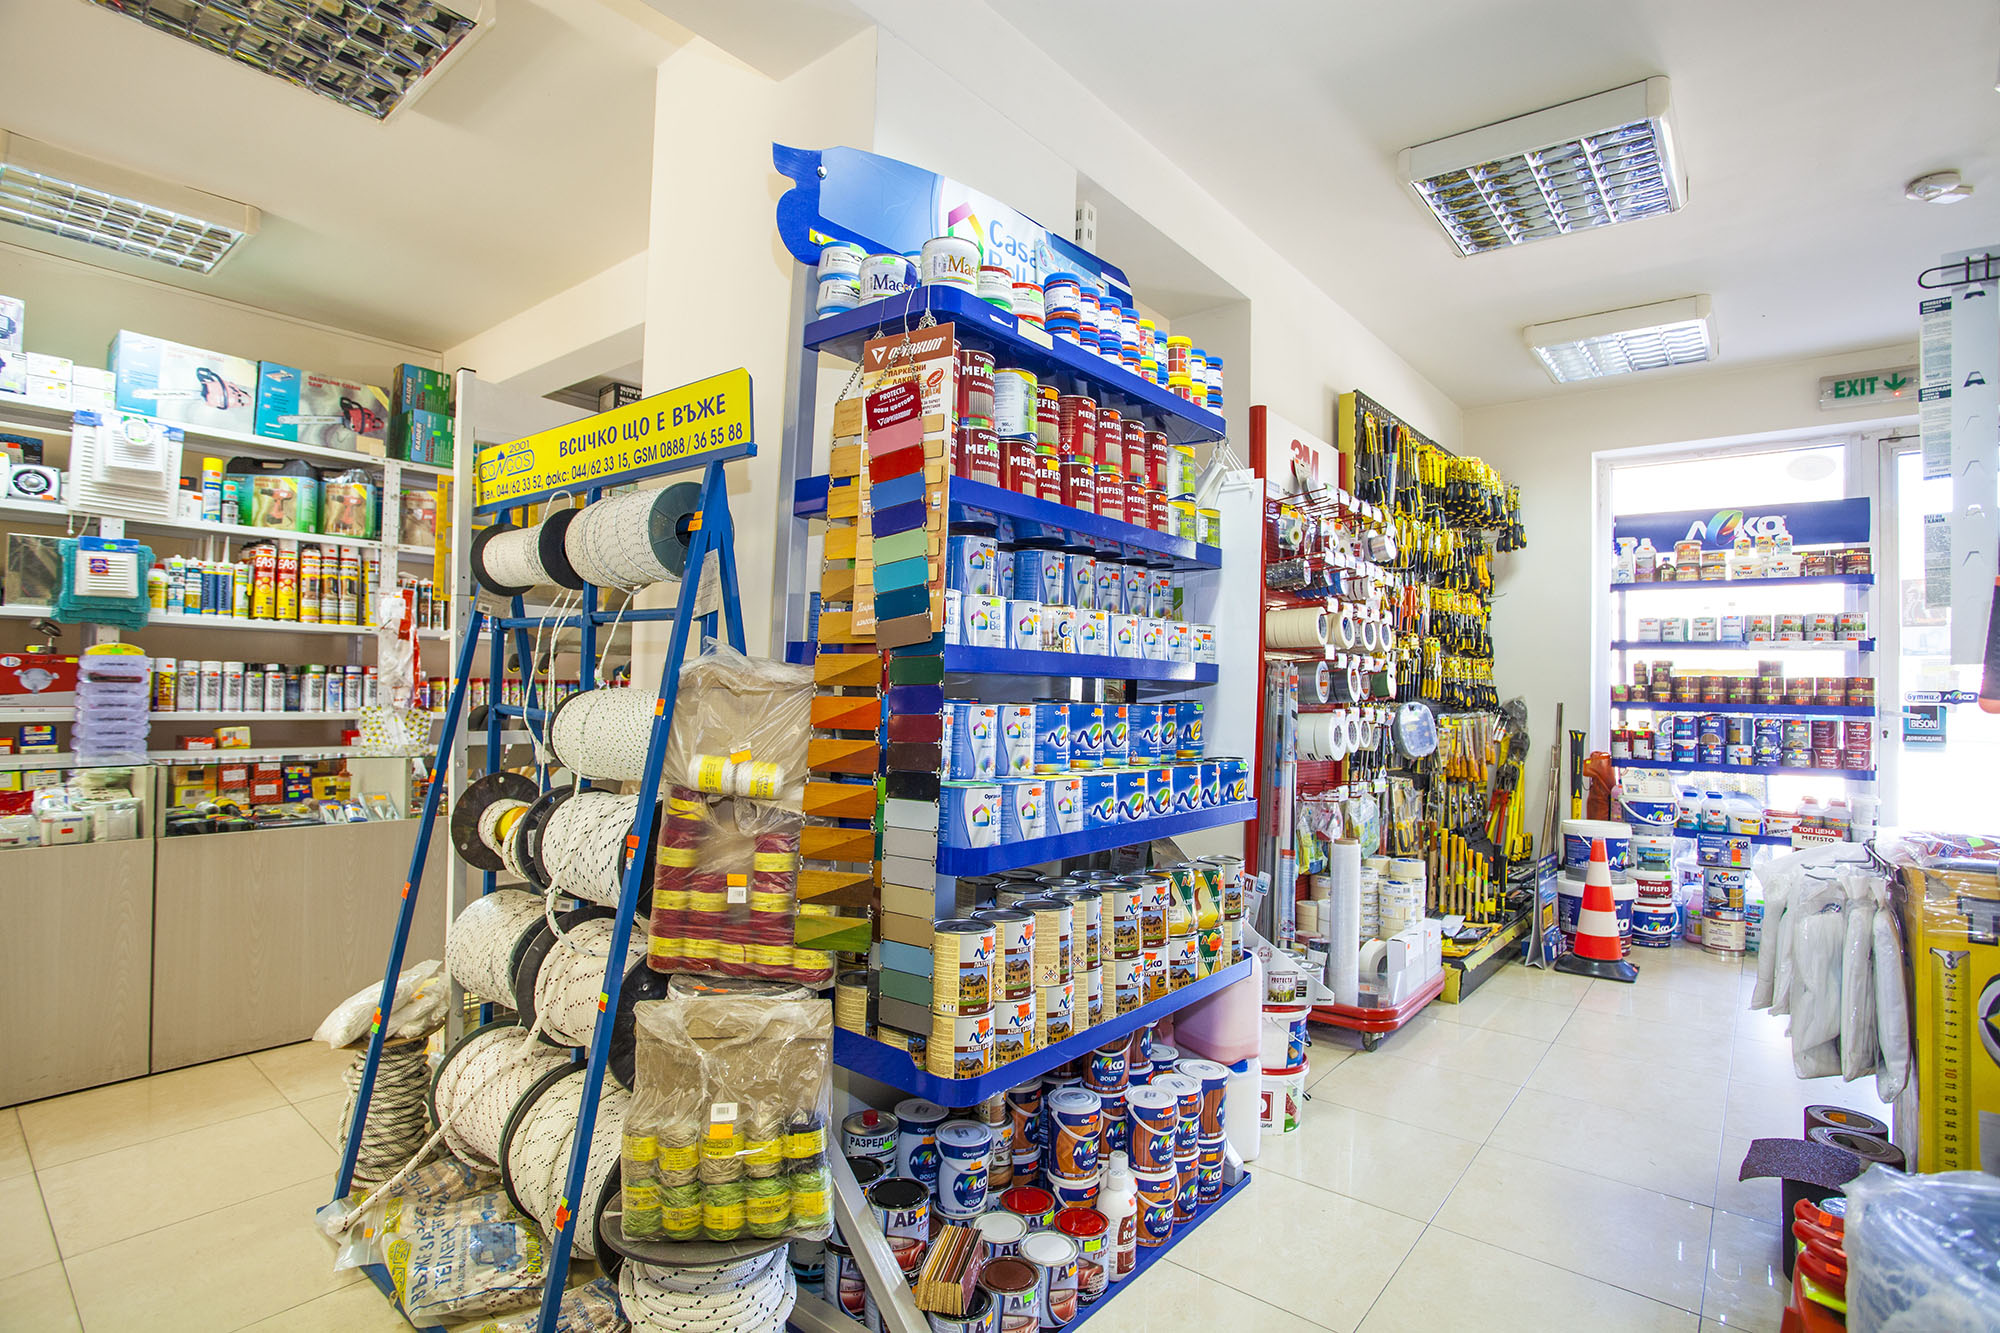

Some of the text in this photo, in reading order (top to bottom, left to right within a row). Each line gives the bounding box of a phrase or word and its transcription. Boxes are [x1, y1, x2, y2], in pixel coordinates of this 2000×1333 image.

[307, 375, 340, 387] GASOLINE
[879, 386, 906, 401] PROTECTA
[1834, 376, 1879, 399] EXIT
[559, 426, 617, 458] ВСИЧКО
[623, 417, 650, 441] ЩО
[657, 411, 666, 431] Е
[673, 393, 726, 427] ВЪЖЕ
[508, 440, 530, 453] 2001
[496, 480, 521, 498] 044/62
[522, 479, 531, 491] 33
[571, 459, 601, 480] 044/62
[603, 455, 615, 472] 33
[618, 452, 631, 469] 15,
[633, 445, 658, 465] GSM
[710, 427, 725, 446] 55
[728, 422, 743, 441] 88
[1911, 720, 1937, 728] BISON
[1798, 826, 1814, 834] ТОП
[1815, 828, 1836, 836] ЦЕНА
[1801, 834, 1834, 843] MEFISTO
[1640, 885, 1669, 893] MEFISTO
